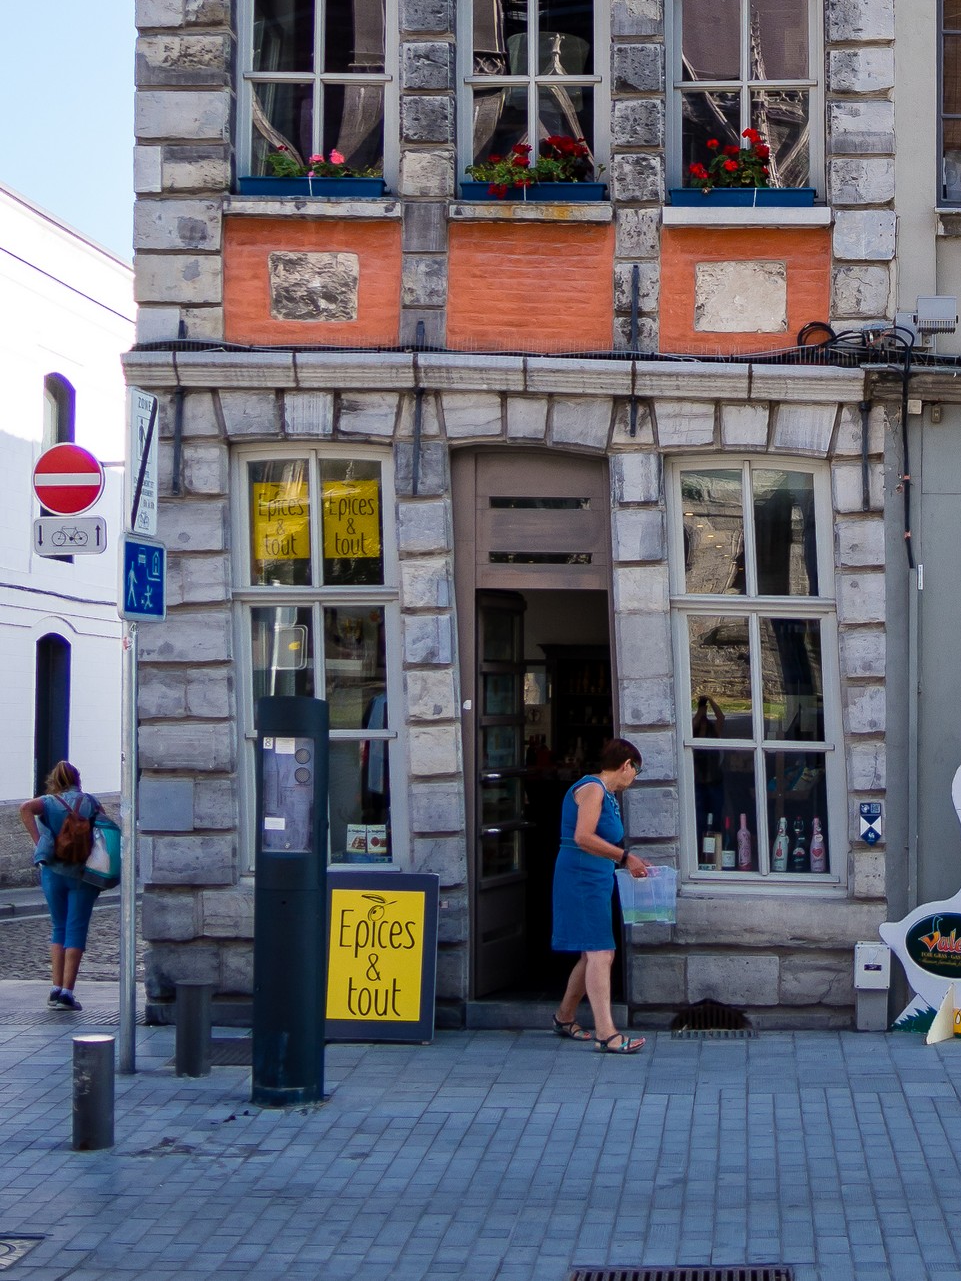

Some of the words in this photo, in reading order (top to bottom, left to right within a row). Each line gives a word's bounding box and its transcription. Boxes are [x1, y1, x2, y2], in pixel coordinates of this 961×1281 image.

[258, 492, 304, 522] Epices
[329, 491, 375, 521] Epices
[276, 519, 286, 536] &
[346, 517, 357, 535] &
[265, 533, 298, 556] tout
[335, 532, 368, 555] tout
[339, 909, 417, 959] Epices
[366, 952, 381, 981] &
[348, 977, 401, 1017] tout
